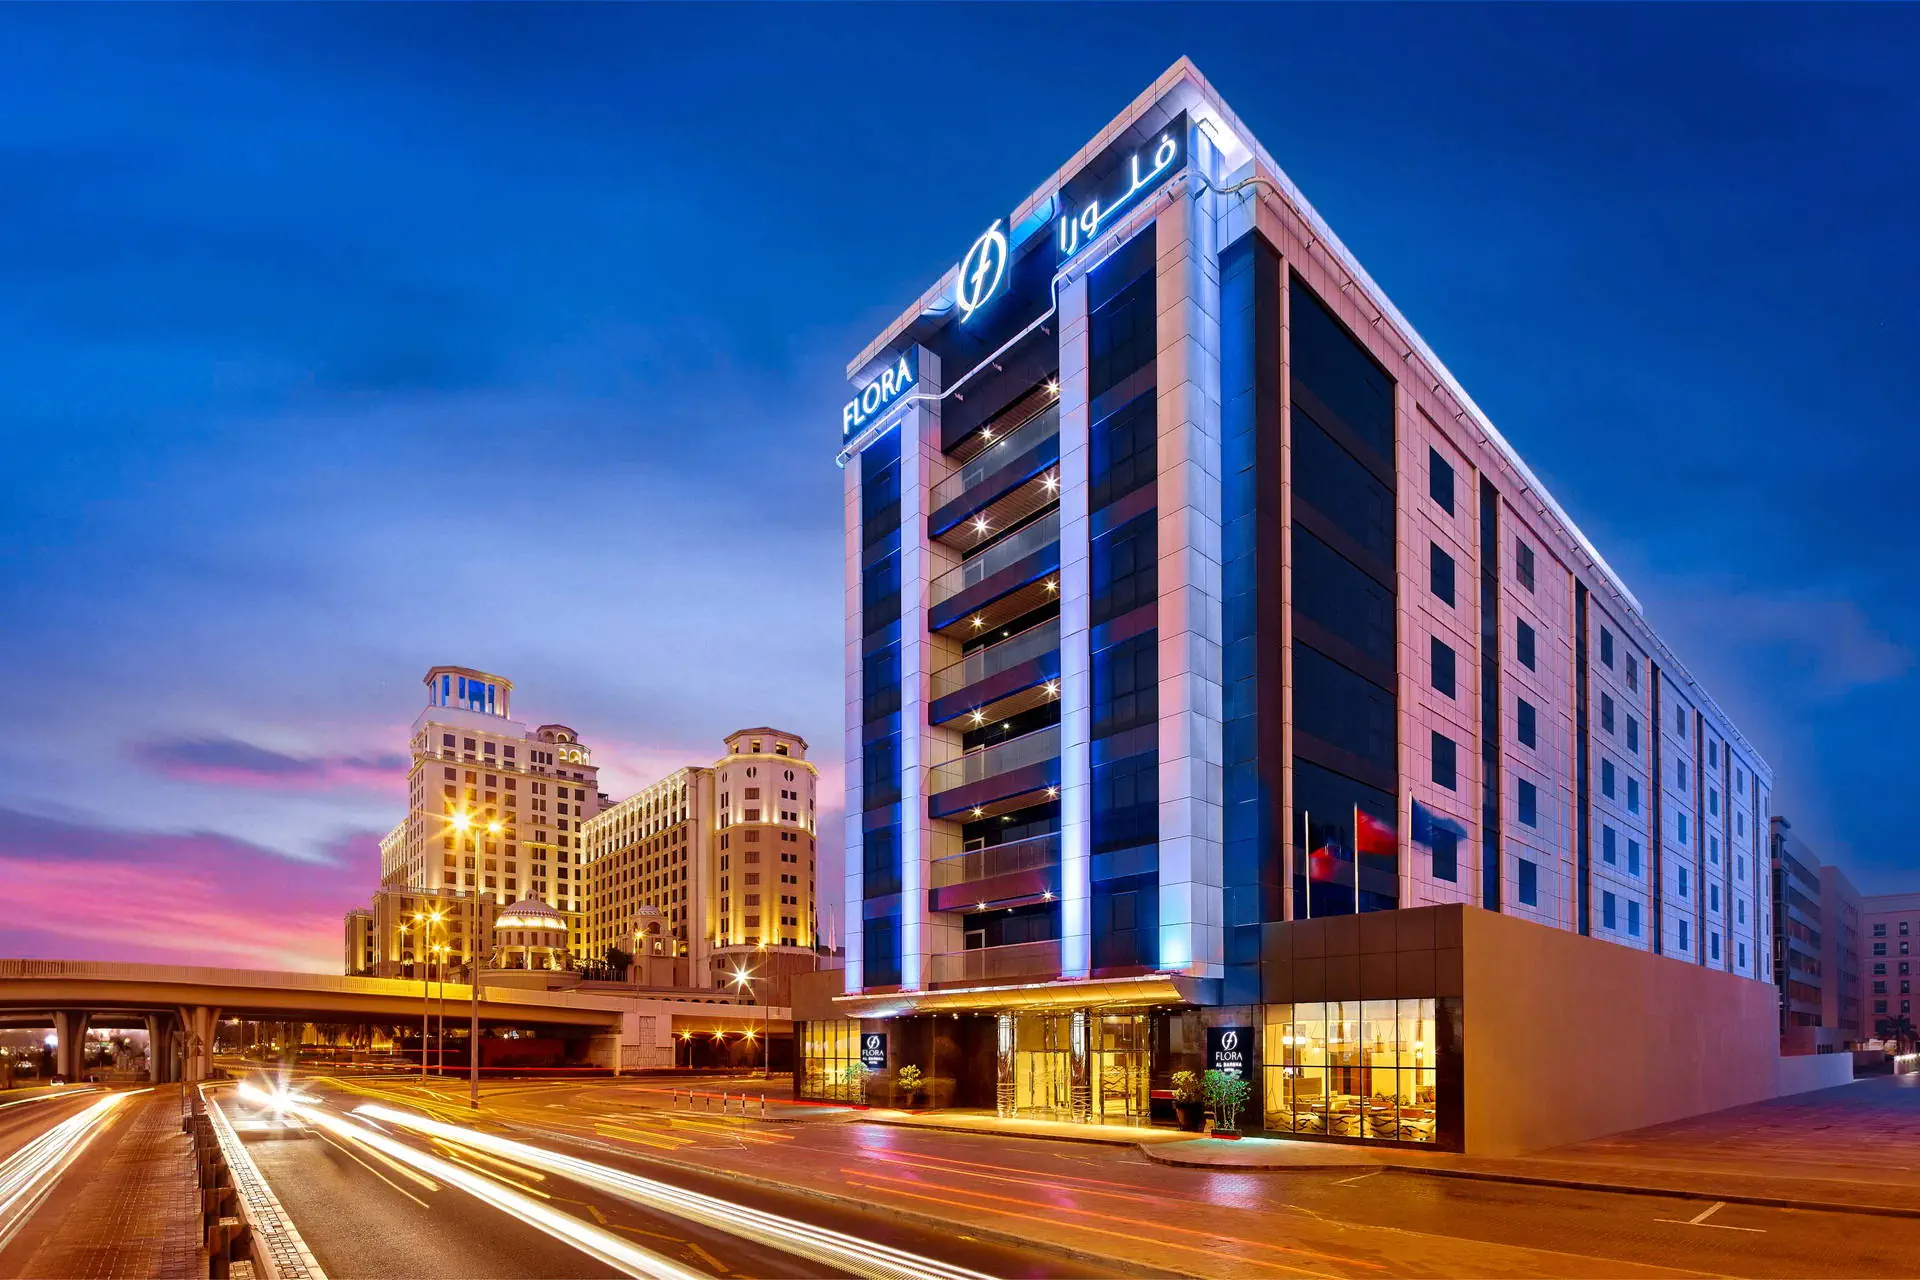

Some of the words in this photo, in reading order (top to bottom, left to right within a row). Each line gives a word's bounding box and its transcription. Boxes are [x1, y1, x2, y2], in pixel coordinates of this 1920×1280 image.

[1061, 135, 1176, 256] فلورا
[843, 357, 912, 434] FLORA
[1215, 1051, 1243, 1061] FLORA
